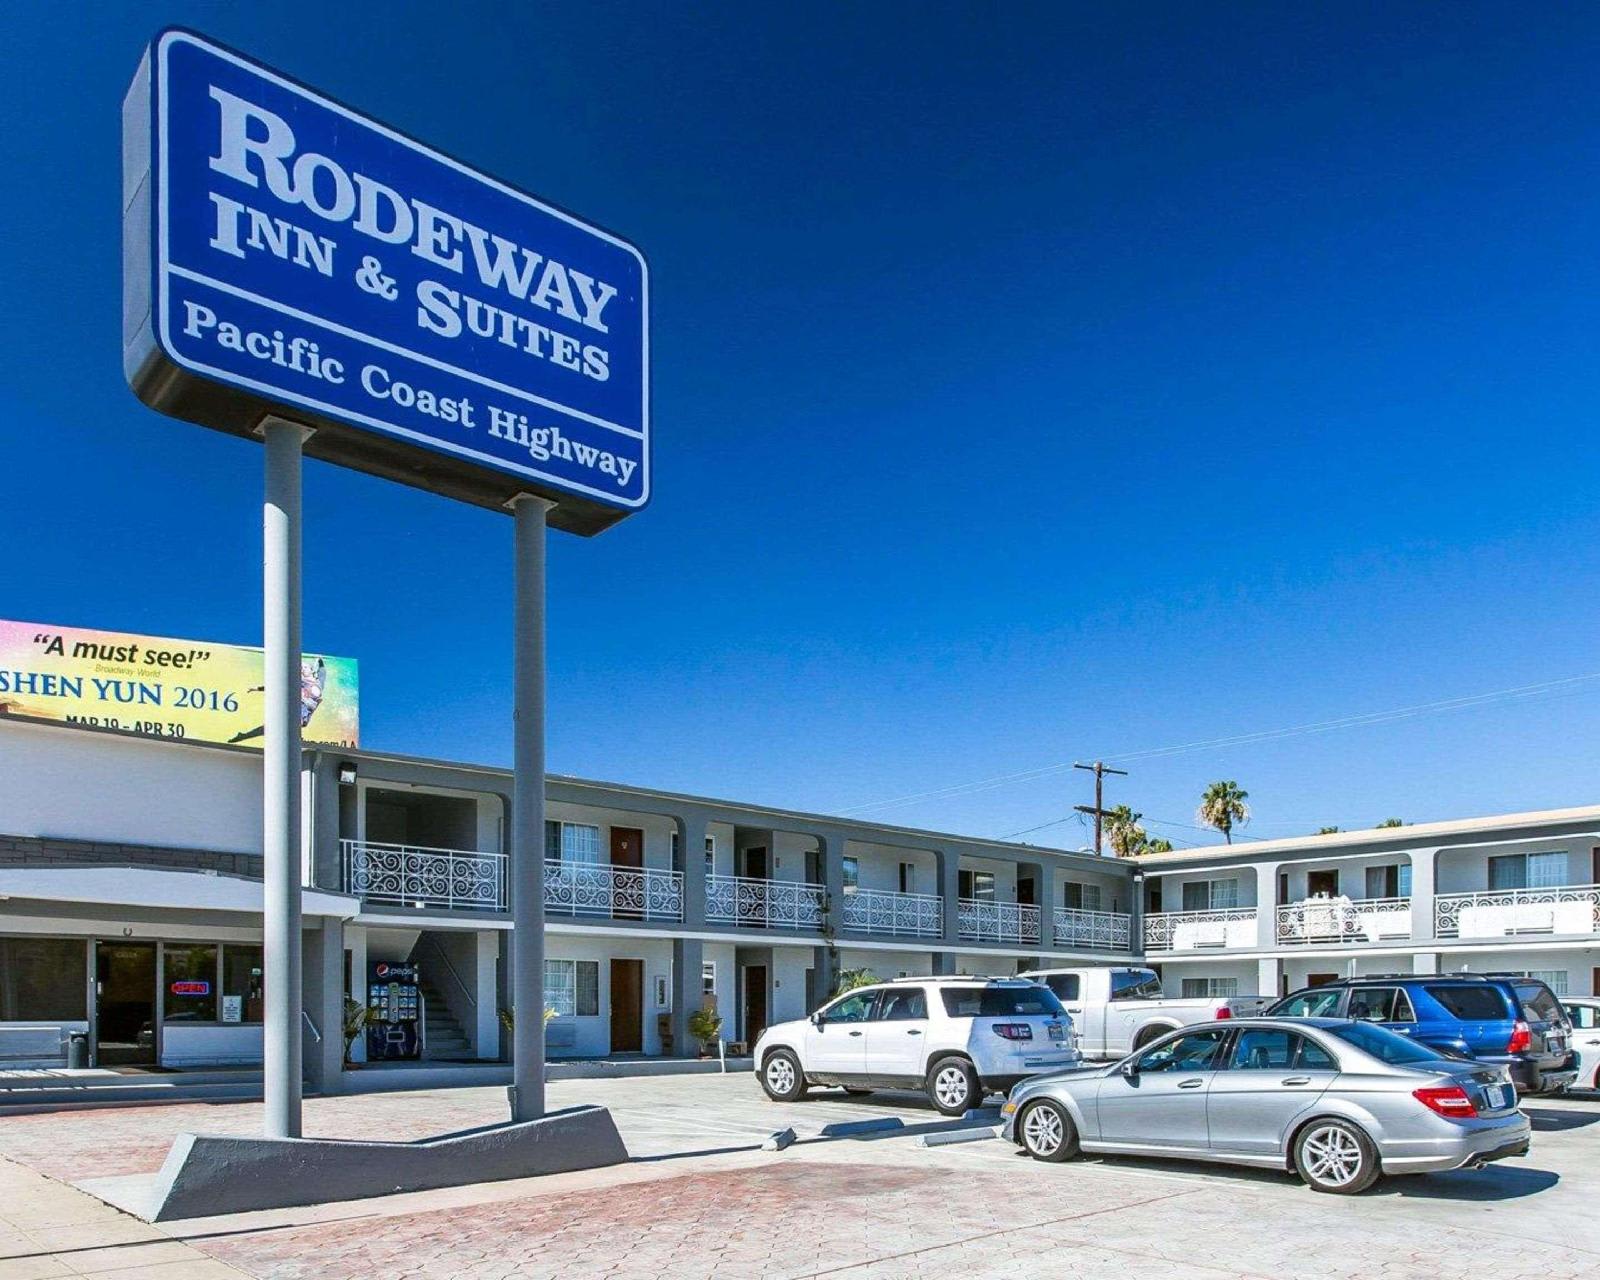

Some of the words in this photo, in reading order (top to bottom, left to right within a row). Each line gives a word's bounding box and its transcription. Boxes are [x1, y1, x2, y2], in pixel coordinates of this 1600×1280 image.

[209, 83, 617, 334] RODEWAY
[209, 191, 337, 278] INN
[355, 255, 399, 301] &
[416, 280, 610, 382] SUITES
[183, 300, 345, 384] Pacific
[361, 364, 476, 428] Coast
[488, 405, 637, 486] Highway
[72, 641, 139, 664] must
[95, 663, 137, 677] Broadway
[137, 668, 162, 679] World
[0, 670, 84, 699] SHEN
[91, 678, 163, 707] YUN
[173, 686, 239, 713] 2016
[167, 723, 185, 738] 30
[170, 983, 206, 993] OPEN
